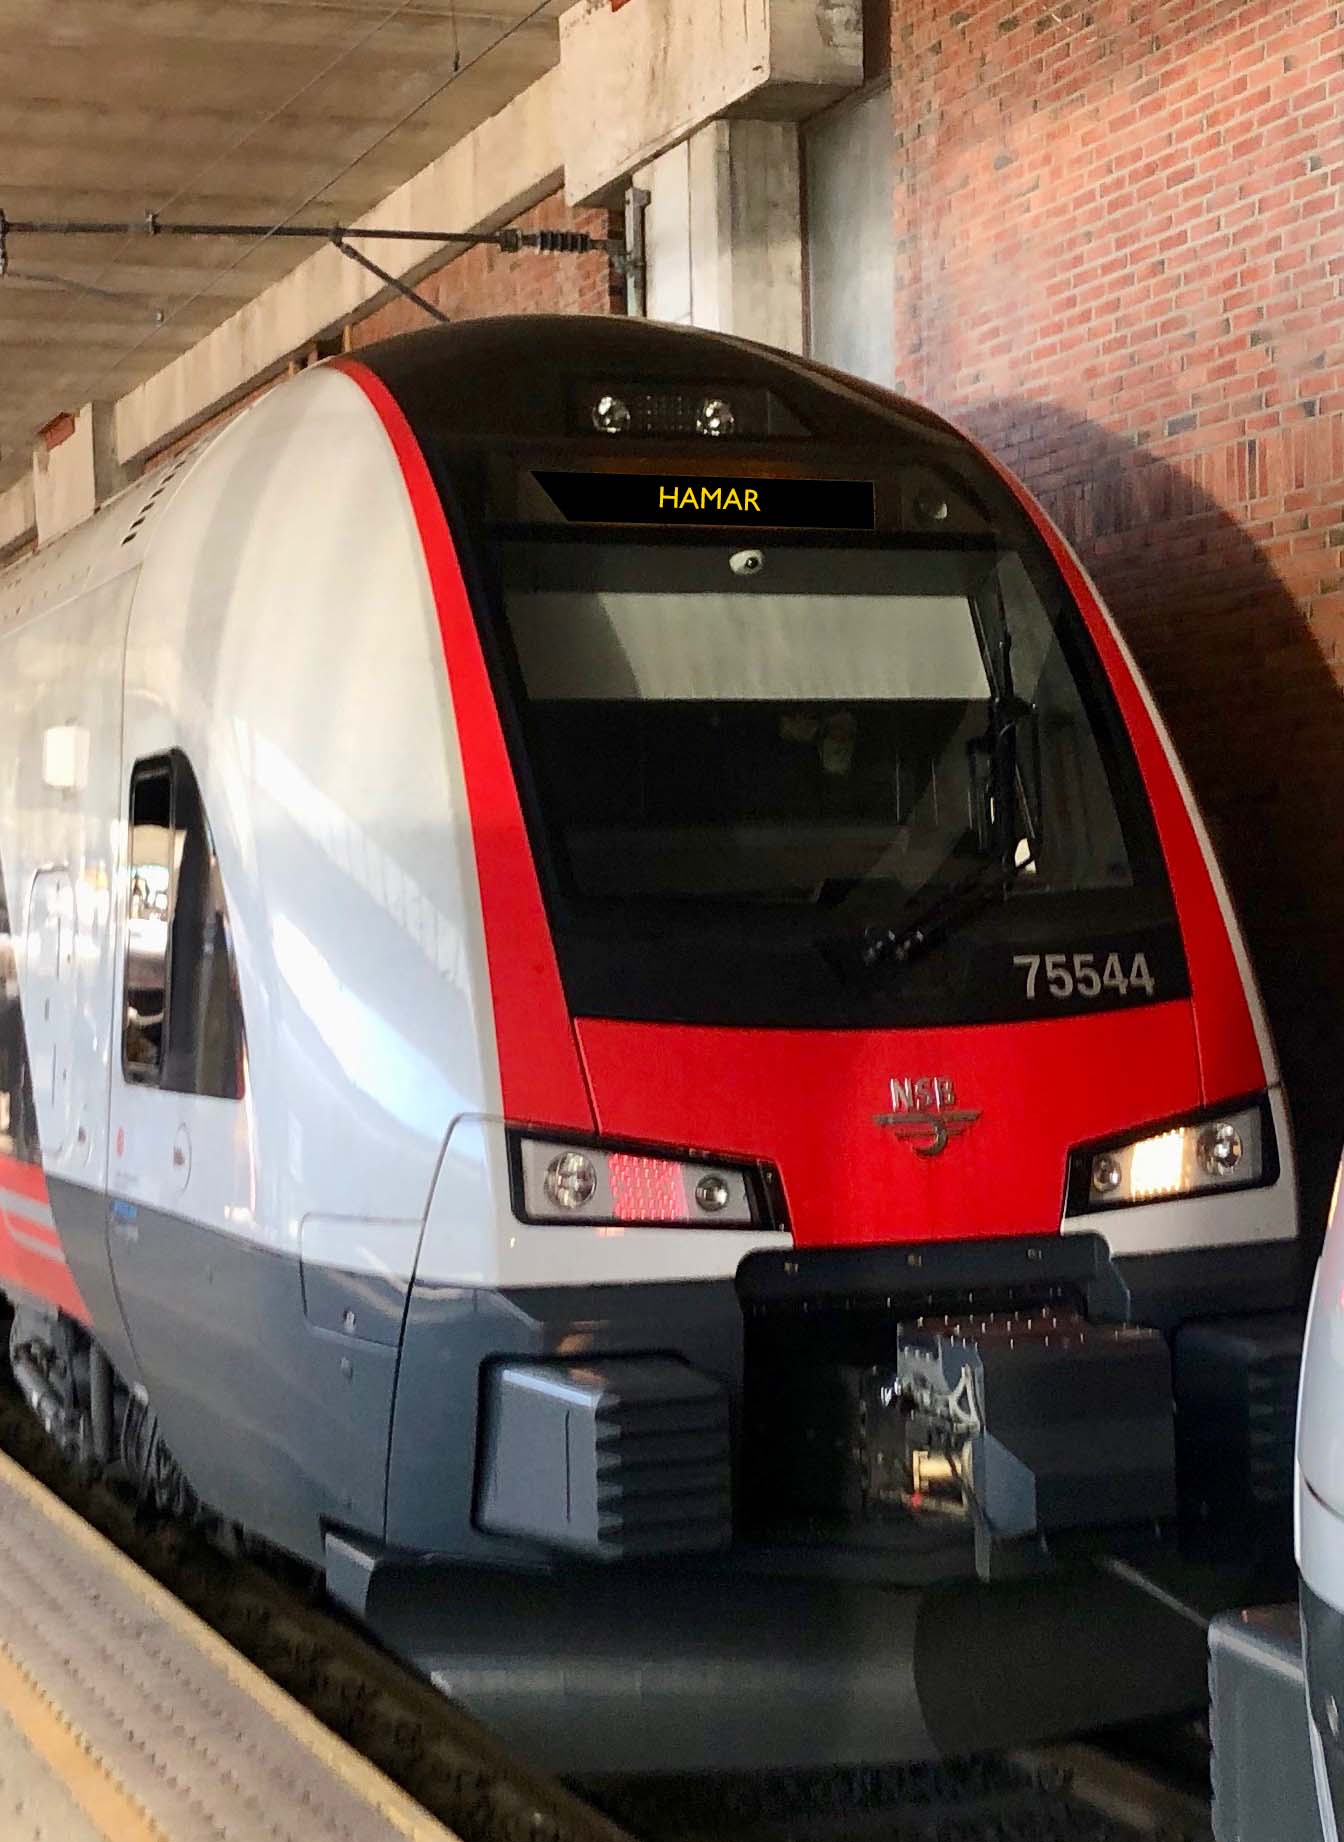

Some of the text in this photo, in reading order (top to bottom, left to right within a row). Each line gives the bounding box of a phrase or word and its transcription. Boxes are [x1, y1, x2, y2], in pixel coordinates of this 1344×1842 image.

[658, 486, 761, 512] HAMAR
[1013, 951, 1155, 999] 75544
[889, 1075, 956, 1112] NSB
